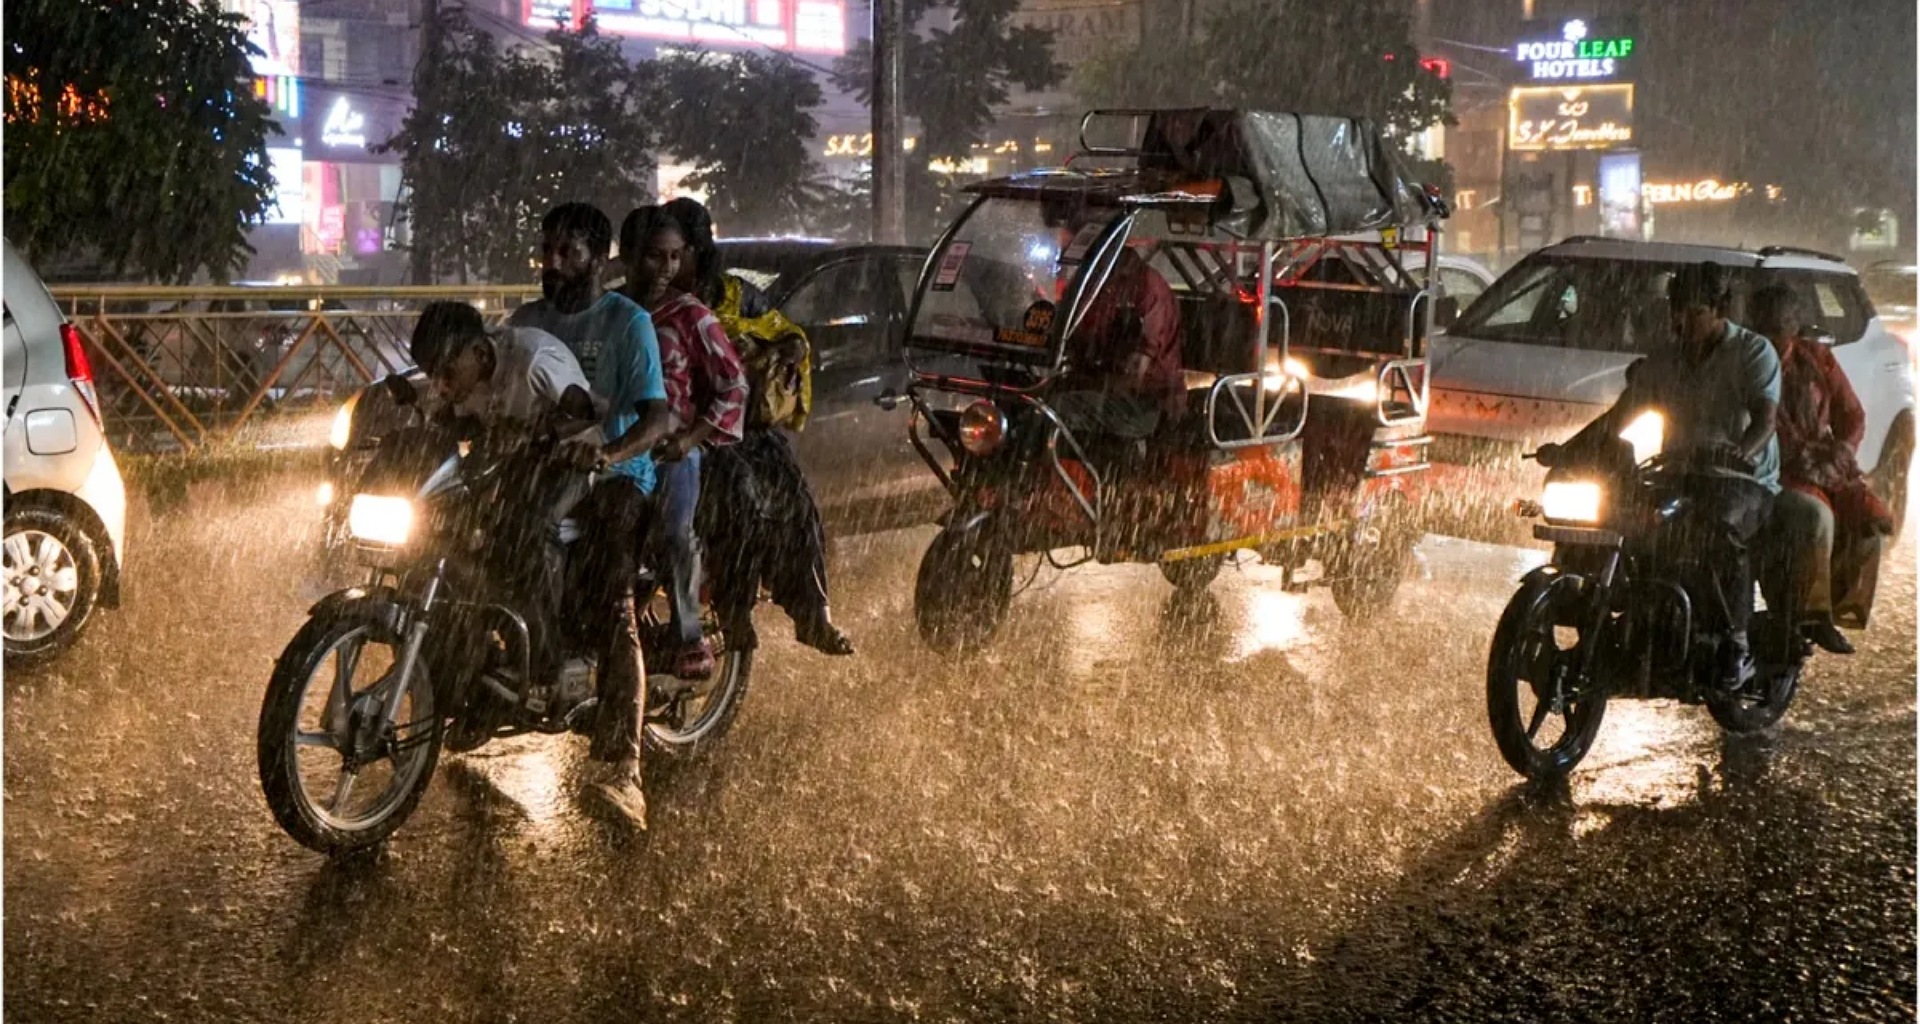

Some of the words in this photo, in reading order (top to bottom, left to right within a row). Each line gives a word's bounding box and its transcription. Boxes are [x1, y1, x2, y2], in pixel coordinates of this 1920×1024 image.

[1517, 41, 1574, 60] FOUR
[1579, 39, 1632, 58] LEAF
[1533, 58, 1614, 78] HOTELS
